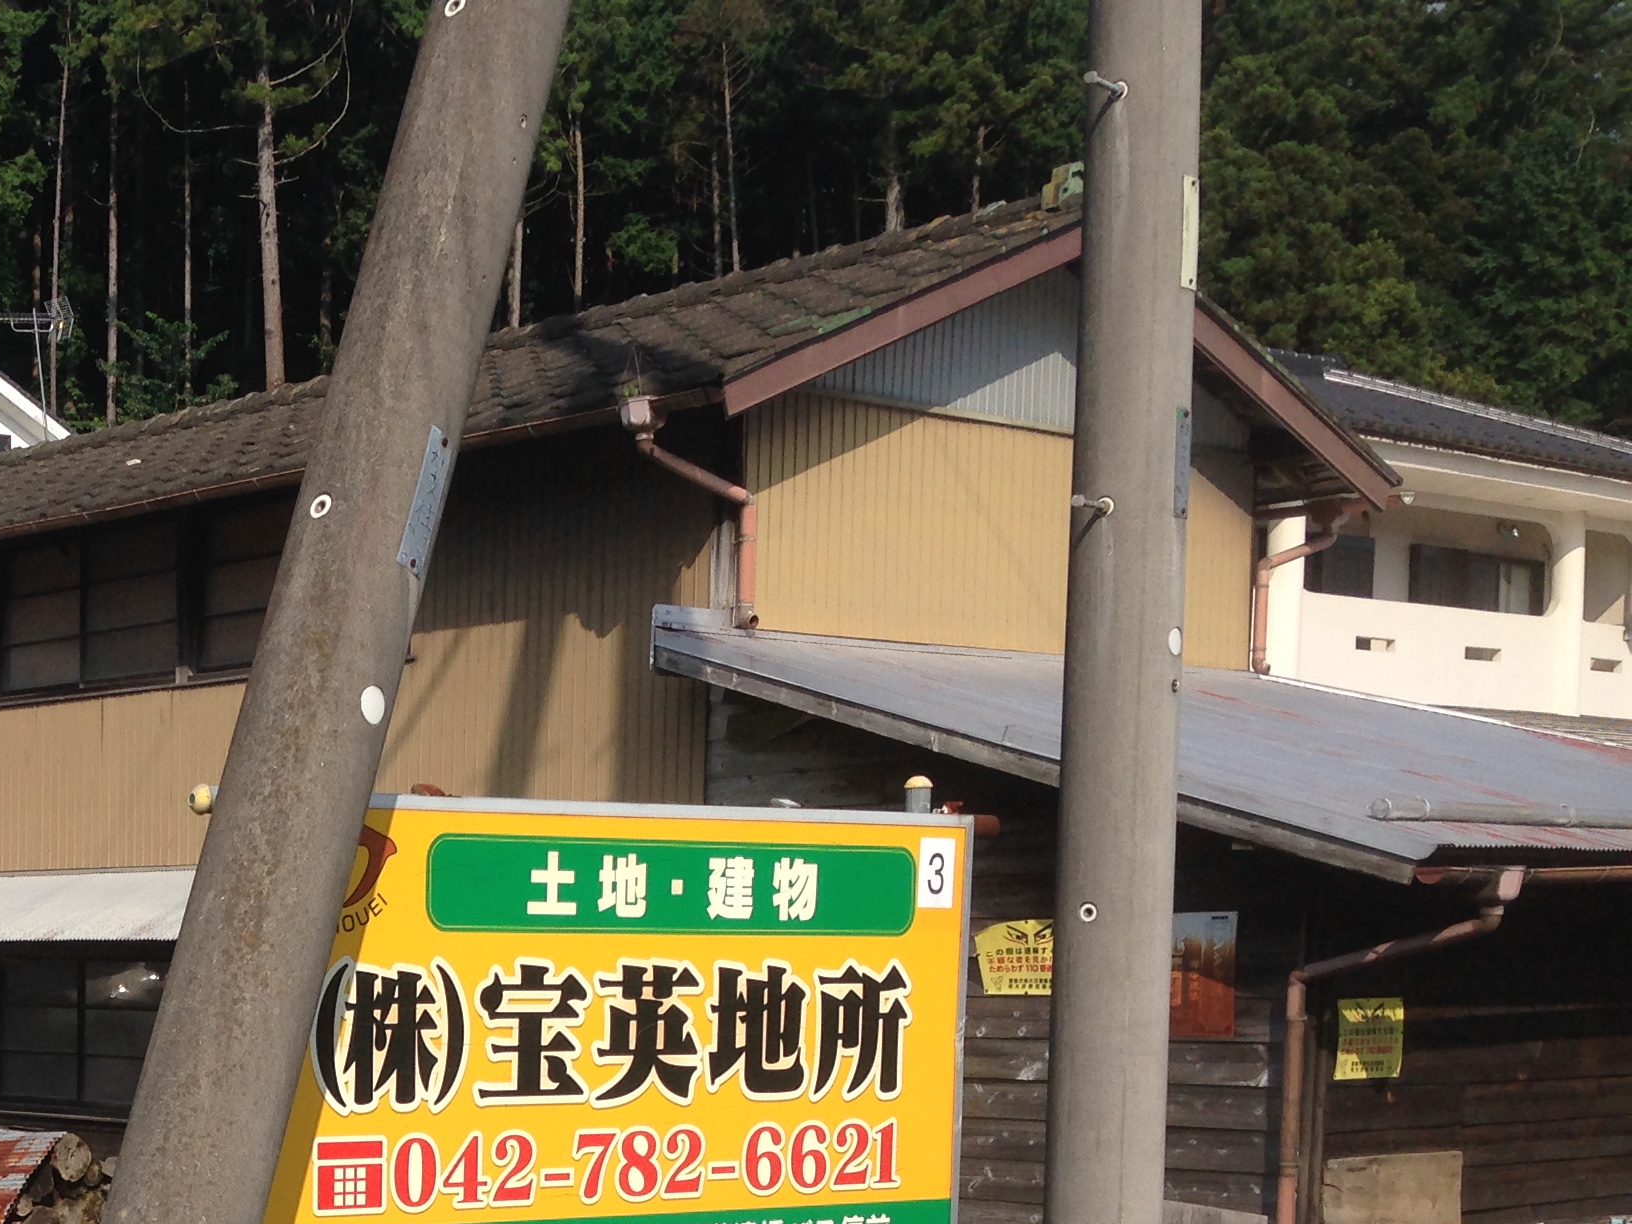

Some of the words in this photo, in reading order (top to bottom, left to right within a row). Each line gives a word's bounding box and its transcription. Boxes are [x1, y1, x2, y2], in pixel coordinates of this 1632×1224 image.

[526, 850, 819, 921] 土地・建物
[927, 852, 946, 896] 3
[336, 892, 389, 935] OUEI
[314, 960, 910, 1110] (株)宝英地所
[392, 1121, 901, 1212] 042-782-6621
